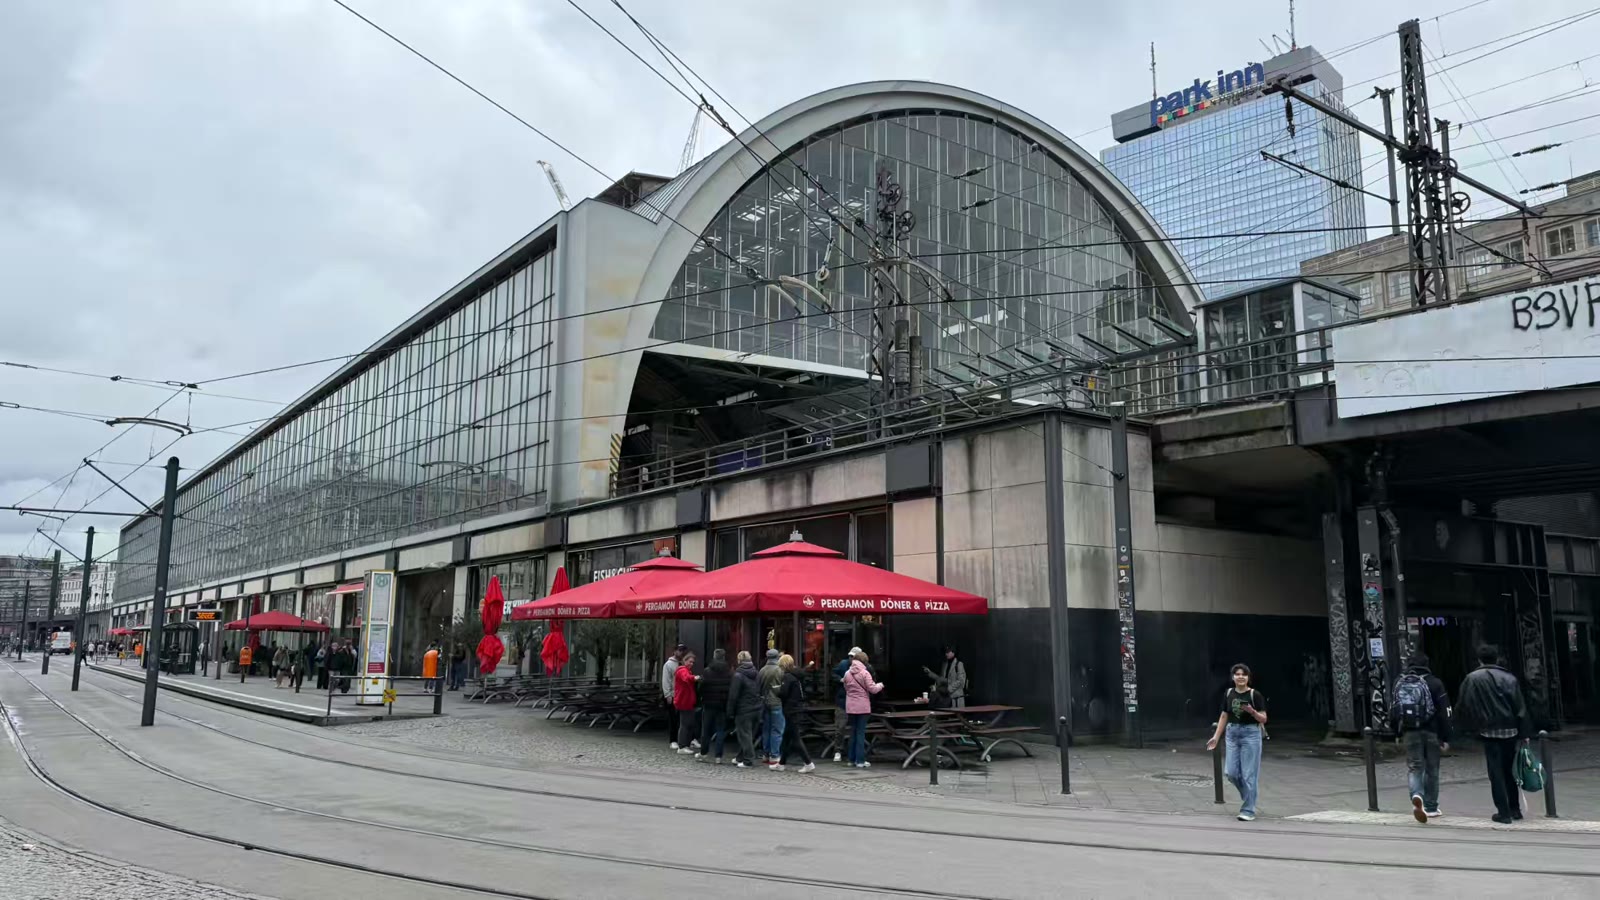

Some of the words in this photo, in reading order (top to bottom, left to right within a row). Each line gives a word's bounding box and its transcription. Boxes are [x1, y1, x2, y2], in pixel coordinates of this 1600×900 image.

[1151, 78, 1213, 126] park
[1217, 62, 1264, 95] inn
[645, 601, 676, 611] PERGAMON
[699, 600, 705, 609] &
[820, 599, 875, 609] PERGAMON
[880, 598, 912, 610] DÖNER
[913, 600, 921, 609] &
